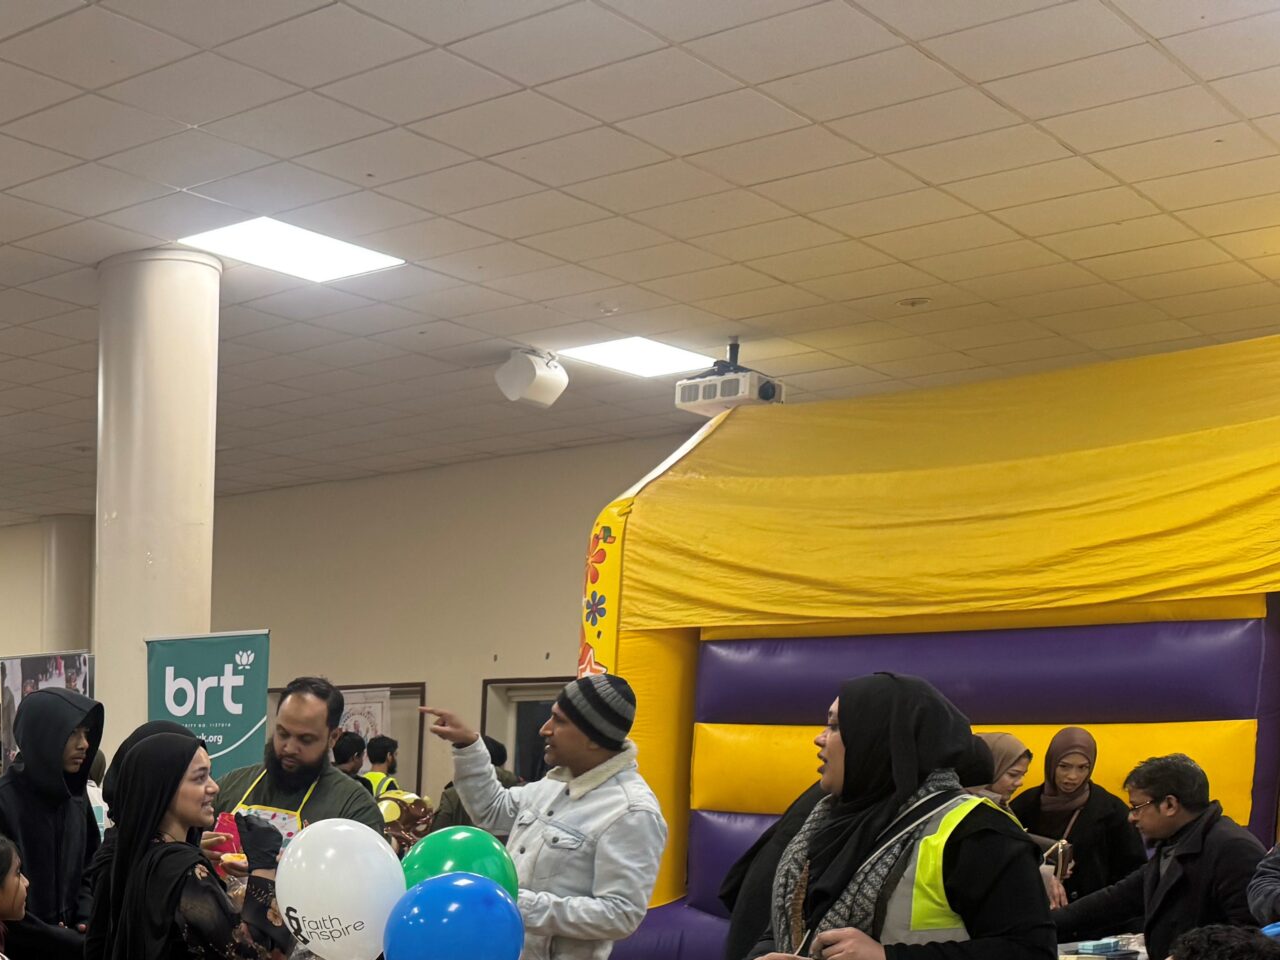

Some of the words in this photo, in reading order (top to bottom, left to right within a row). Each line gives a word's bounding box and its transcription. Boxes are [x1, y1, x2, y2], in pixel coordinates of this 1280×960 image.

[165, 663, 245, 717] brt
[301, 915, 342, 931] faith
[305, 920, 365, 942] inspire
